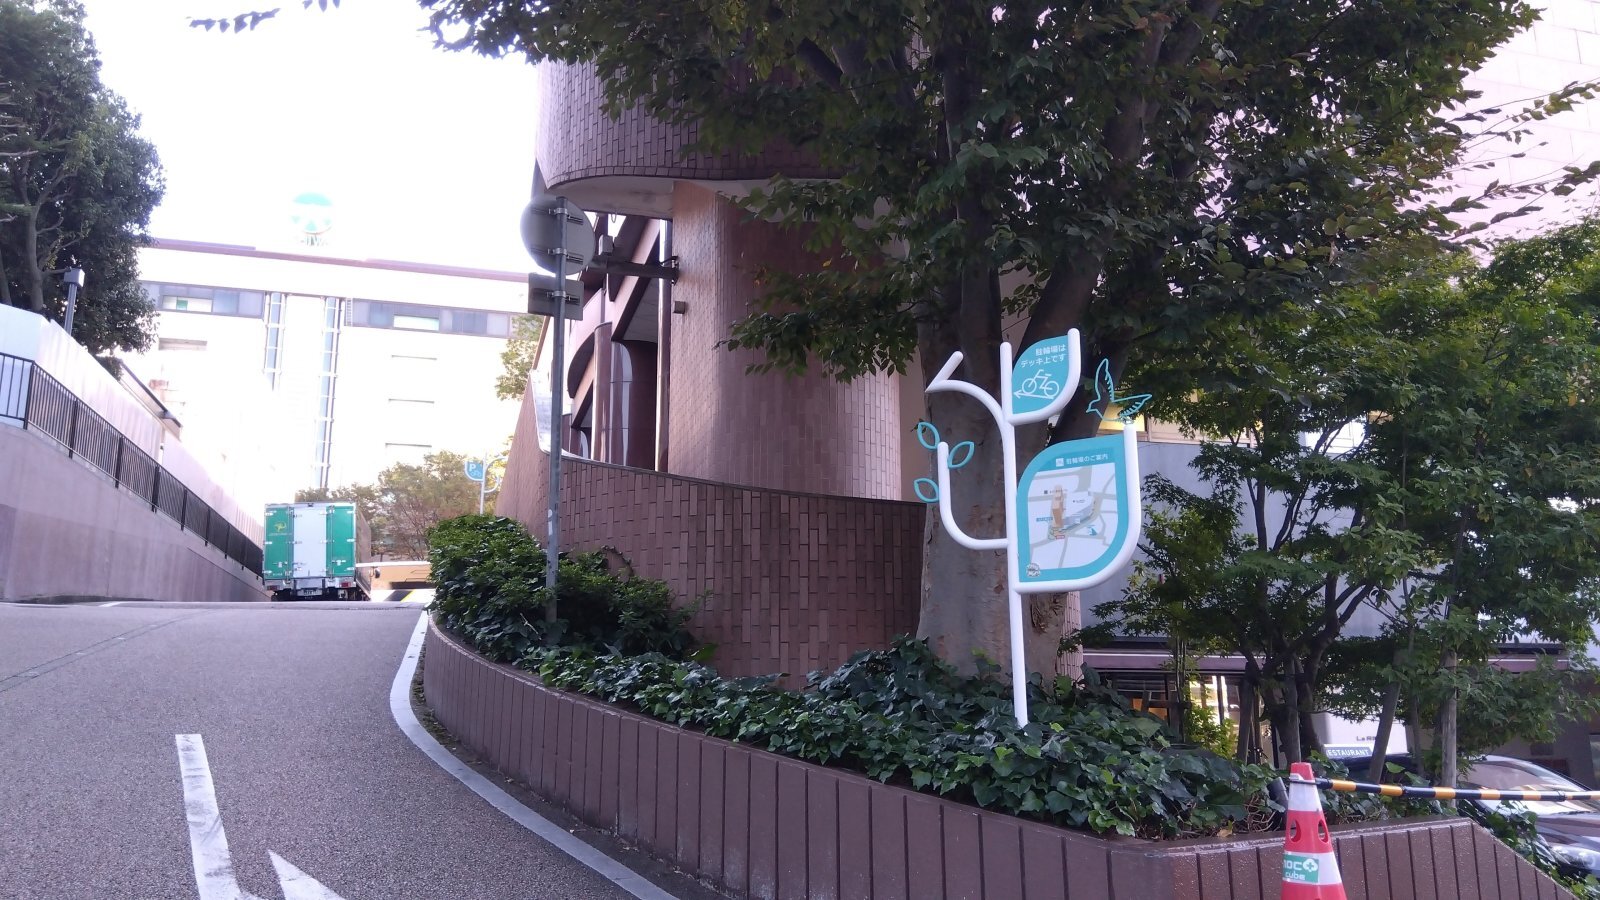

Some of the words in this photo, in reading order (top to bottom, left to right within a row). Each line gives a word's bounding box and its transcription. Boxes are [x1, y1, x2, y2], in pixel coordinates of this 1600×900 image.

[1021, 353, 1066, 368] デッキ上です
[469, 463, 477, 472] P
[1326, 748, 1370, 758] ESTAURANT
